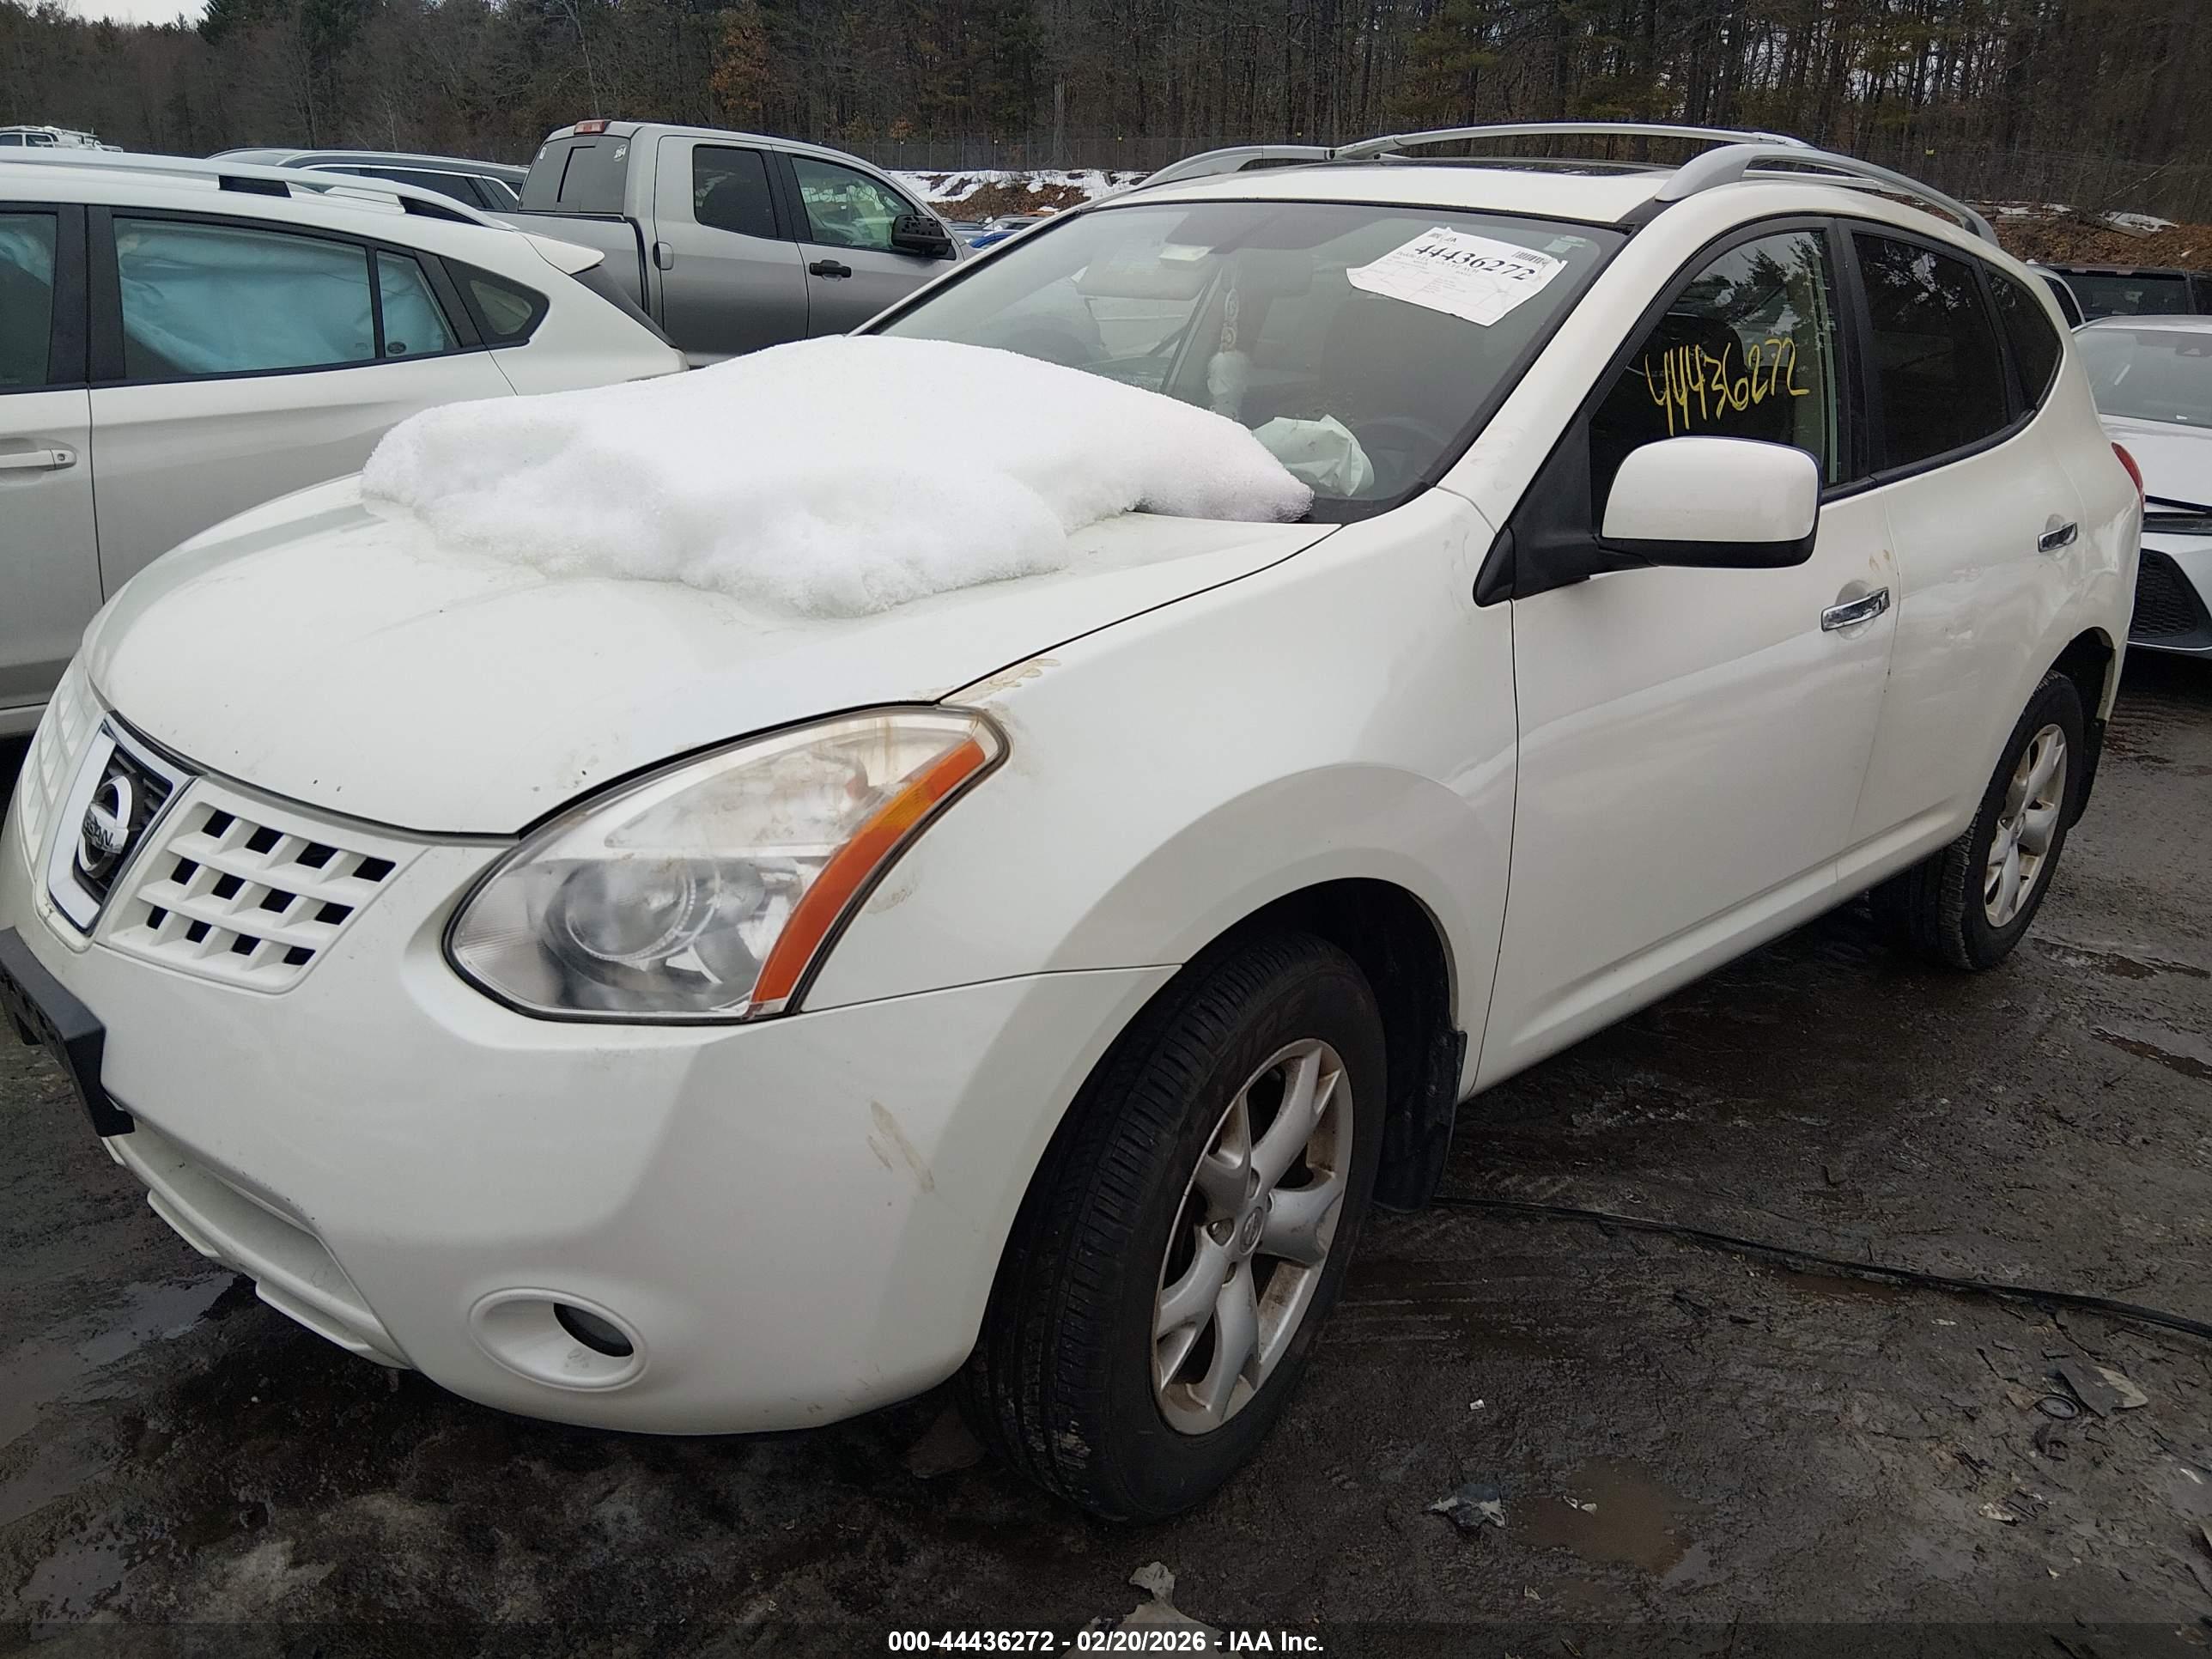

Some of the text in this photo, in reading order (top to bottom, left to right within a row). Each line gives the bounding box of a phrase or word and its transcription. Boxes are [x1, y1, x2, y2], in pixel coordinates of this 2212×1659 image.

[1414, 244, 1537, 281] 44436272
[1644, 337, 1810, 437] 44436272
[82, 814, 113, 846] SSAN
